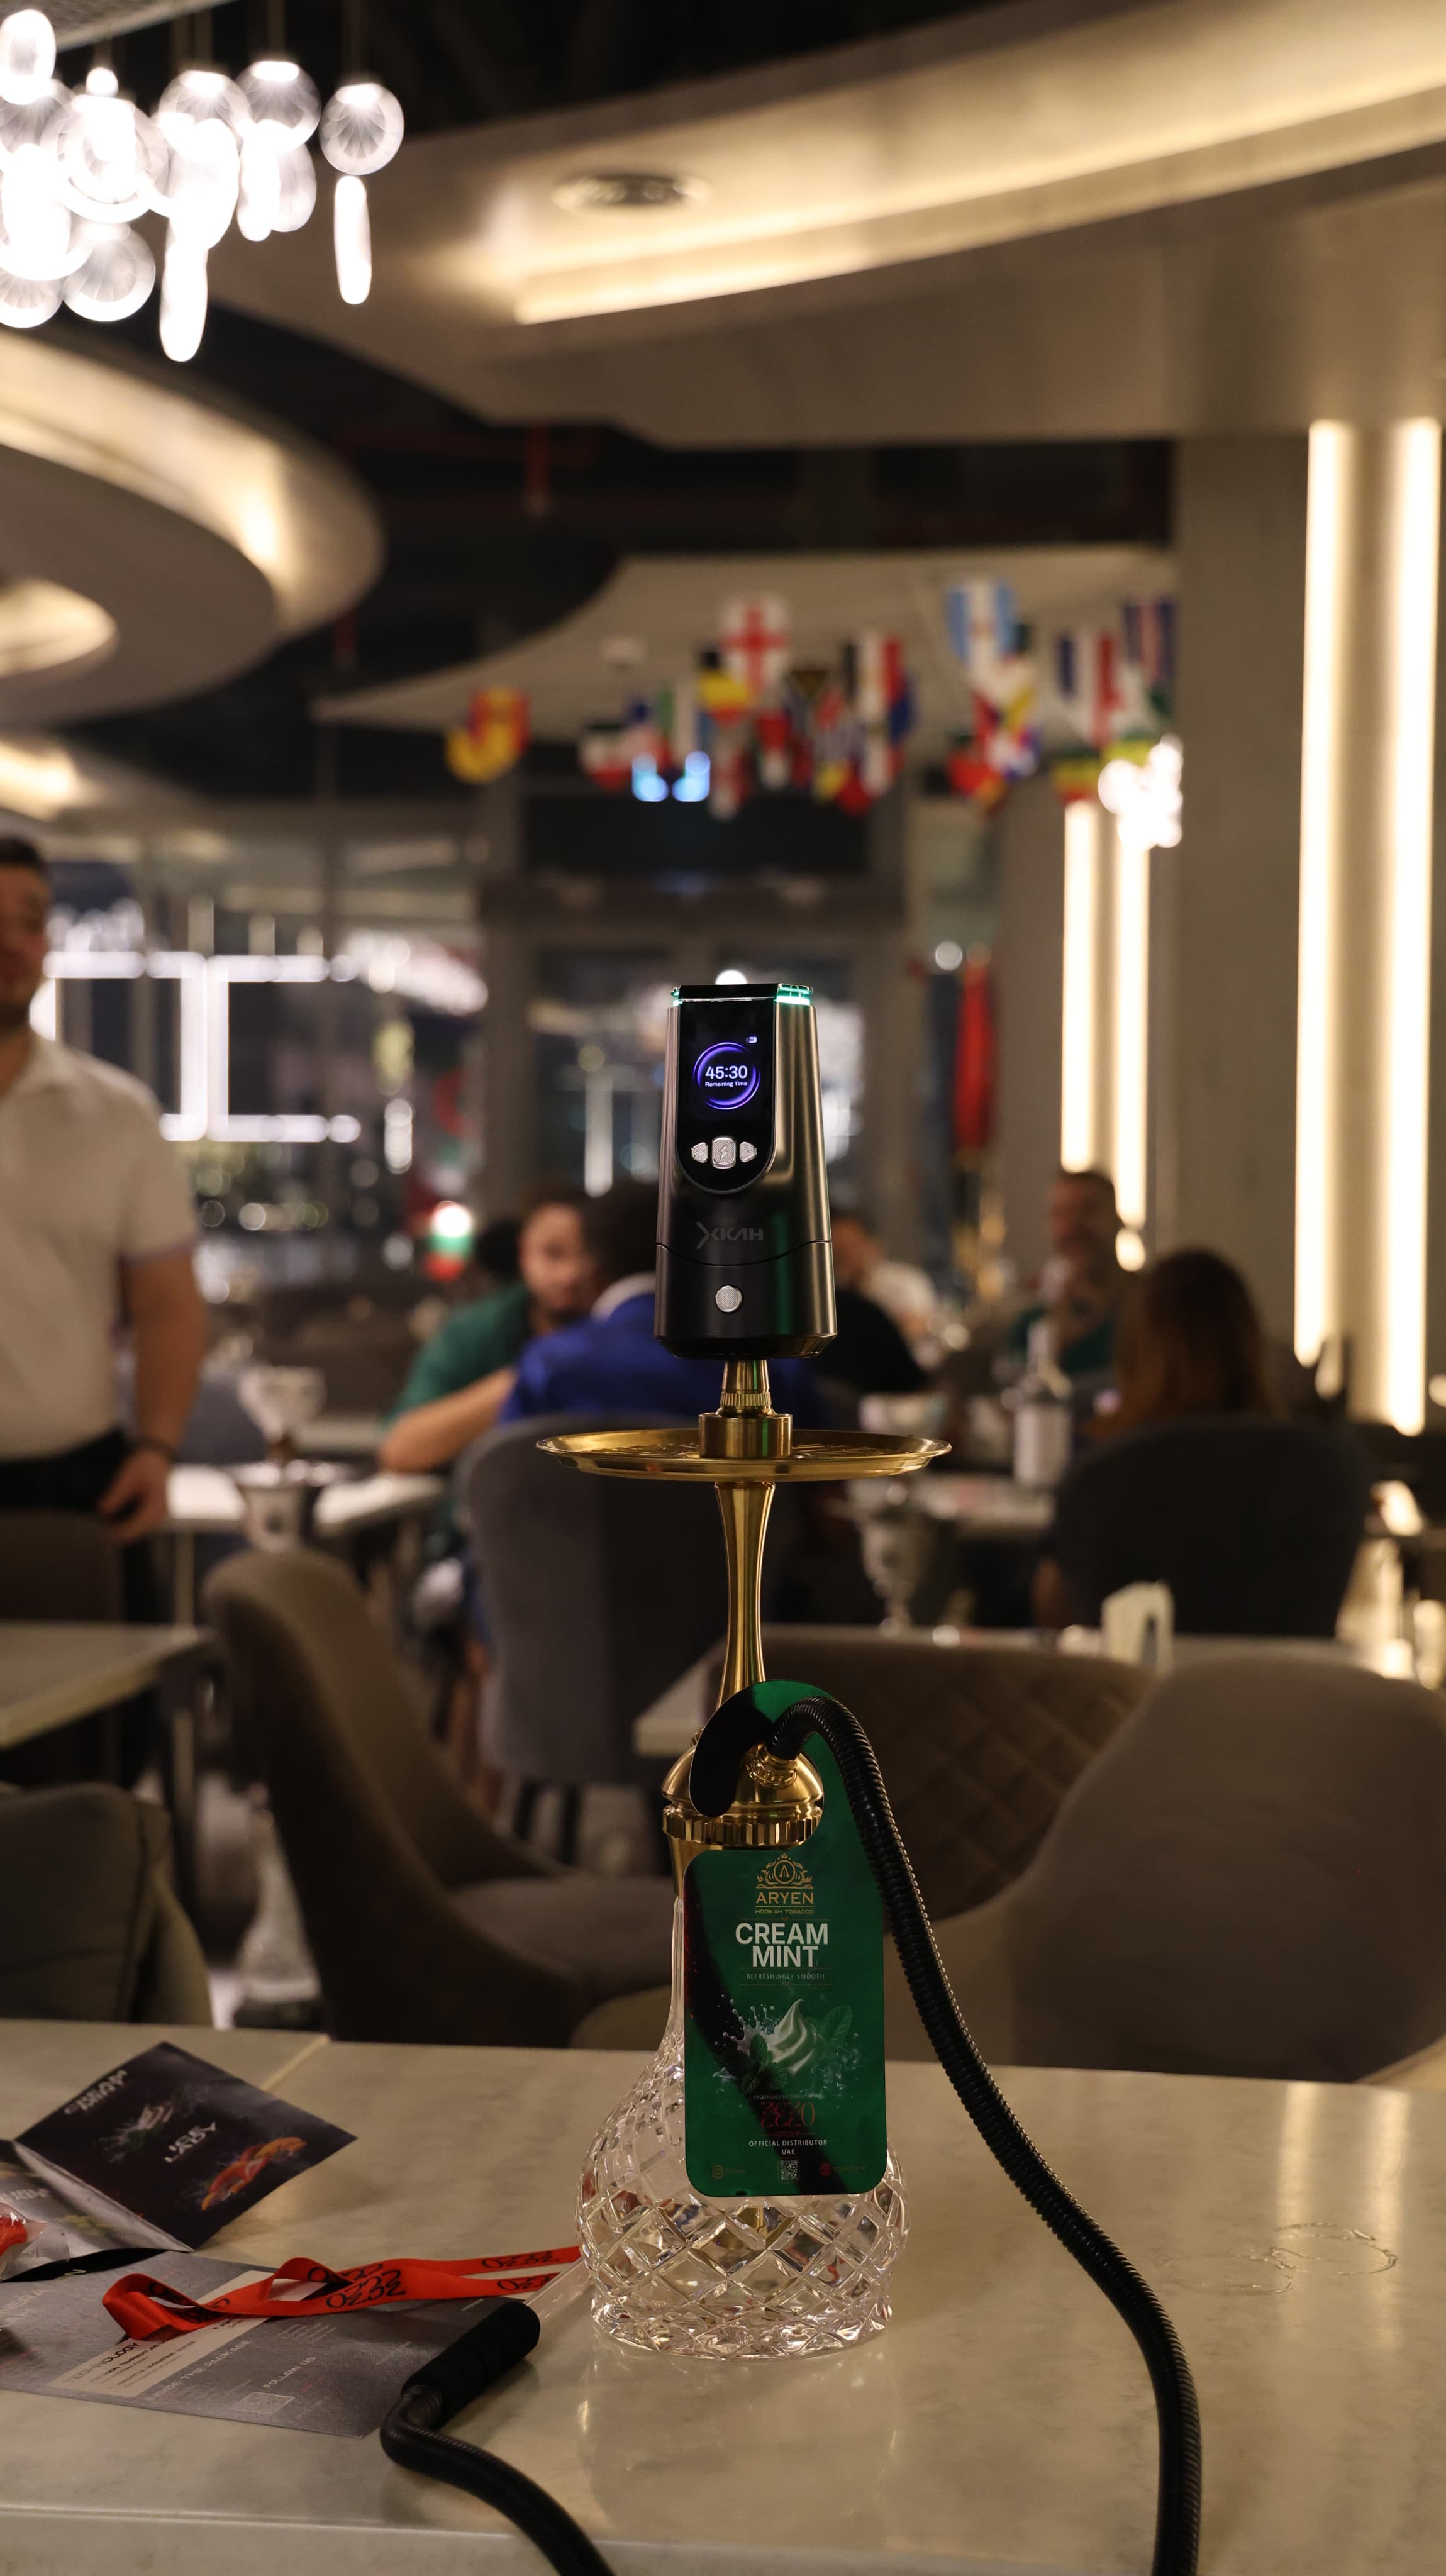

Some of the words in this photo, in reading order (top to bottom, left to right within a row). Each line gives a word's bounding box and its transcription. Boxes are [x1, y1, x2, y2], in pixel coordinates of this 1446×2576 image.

[705, 1065, 748, 1079] 45:30
[755, 1892, 814, 1904] ARYEN
[735, 1922, 828, 1945] CREAM
[752, 1945, 818, 1967] MINT
